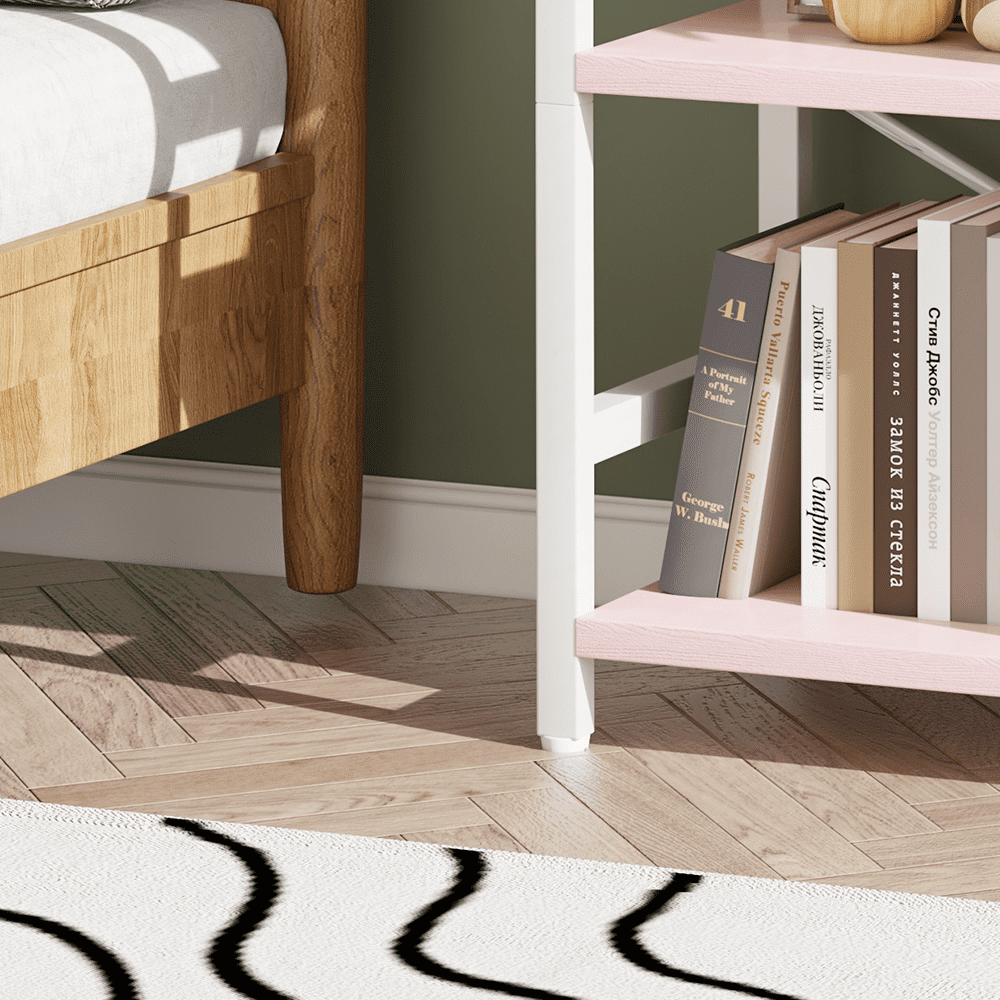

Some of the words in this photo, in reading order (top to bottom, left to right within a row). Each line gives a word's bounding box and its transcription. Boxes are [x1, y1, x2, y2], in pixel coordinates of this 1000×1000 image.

[718, 298, 746, 322] 41
[773, 280, 790, 326] Puerto
[892, 272, 900, 343] ДЖАННЕТТ
[928, 307, 941, 346] Стив
[700, 365, 708, 375] A
[709, 367, 747, 385] Portrait
[763, 332, 782, 385] Vallarta
[811, 304, 824, 412] ДЖОВАНЬОЛИ
[892, 352, 900, 396] УОЛЛС
[926, 350, 941, 406] Джобс
[704, 390, 736, 406] Father
[708, 380, 719, 390] of
[719, 383, 735, 395] My
[753, 389, 771, 446] Squeeze
[926, 410, 941, 468] Уолтер
[675, 504, 691, 519] W.
[693, 510, 730, 530] Bush
[681, 491, 725, 513] George
[806, 476, 831, 567] Спартак
[928, 471, 941, 550] Айзексон
